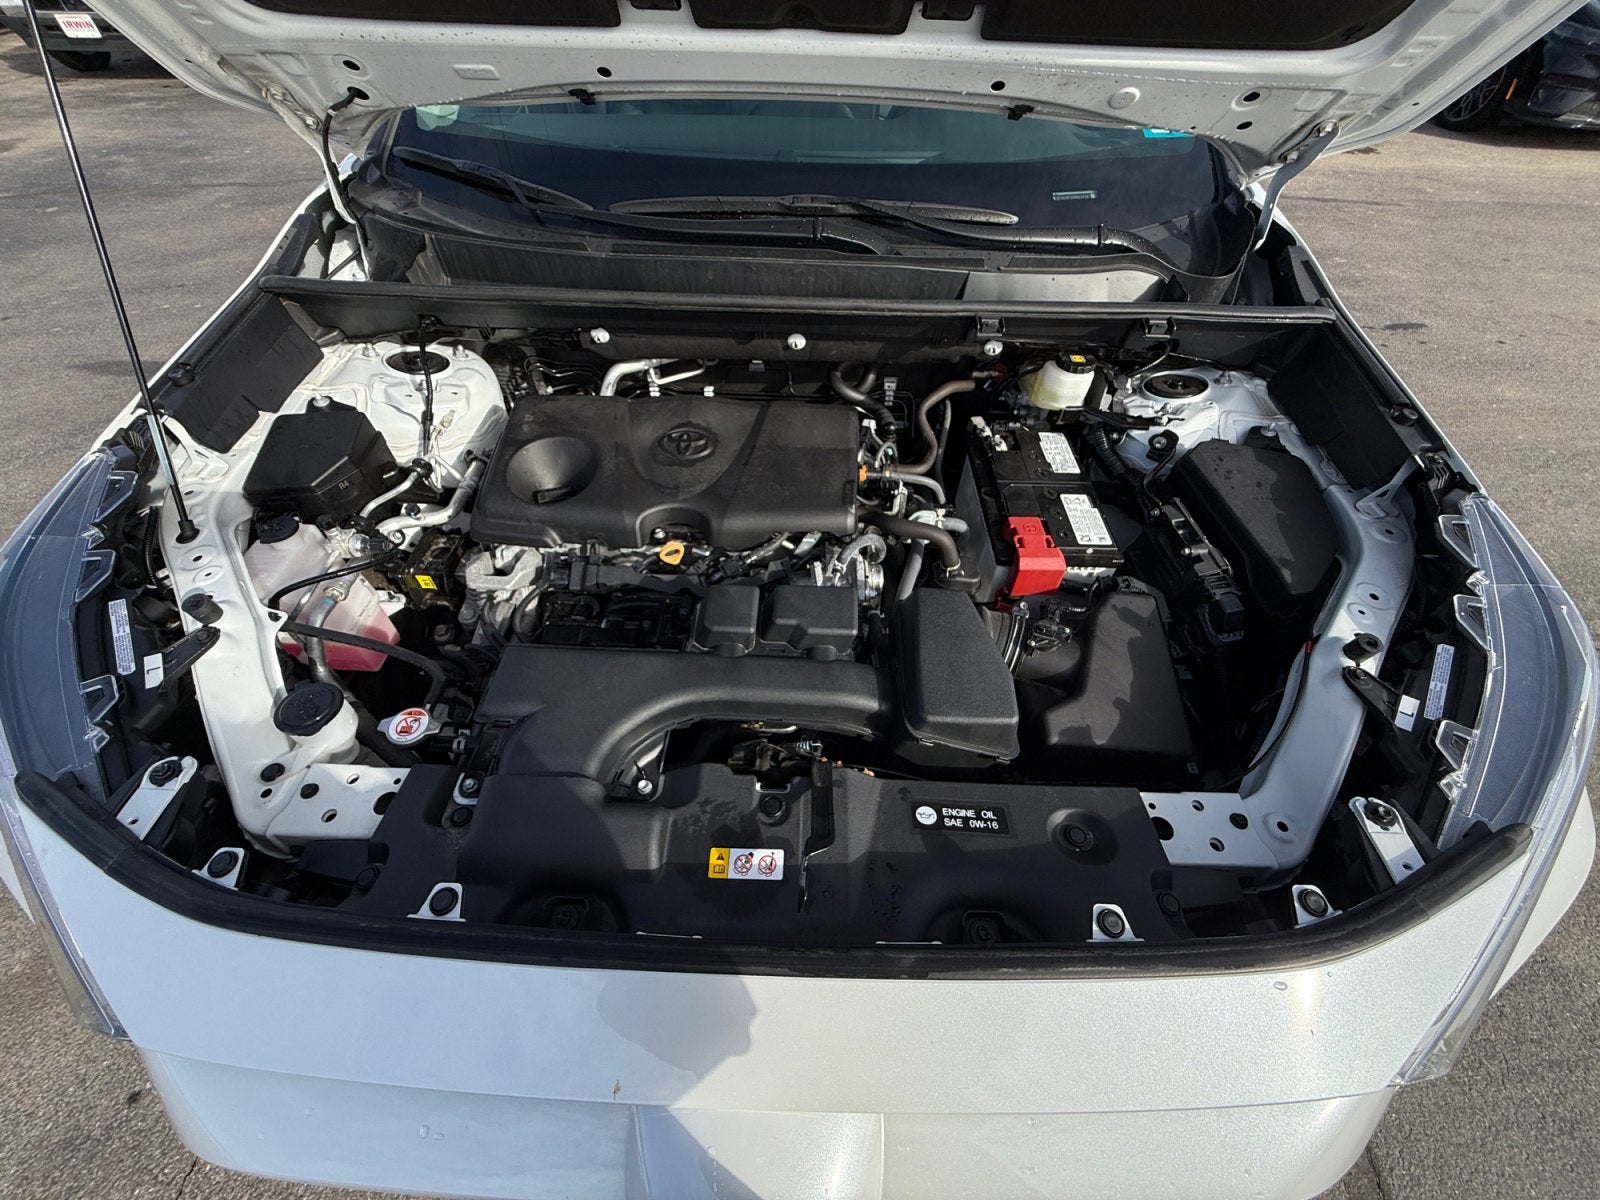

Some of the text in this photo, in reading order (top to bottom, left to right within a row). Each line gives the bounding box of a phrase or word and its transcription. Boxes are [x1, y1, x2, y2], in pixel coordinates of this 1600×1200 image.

[942, 807, 997, 819] ENGINE OIL
[943, 818, 999, 829] SAE 0W-16
